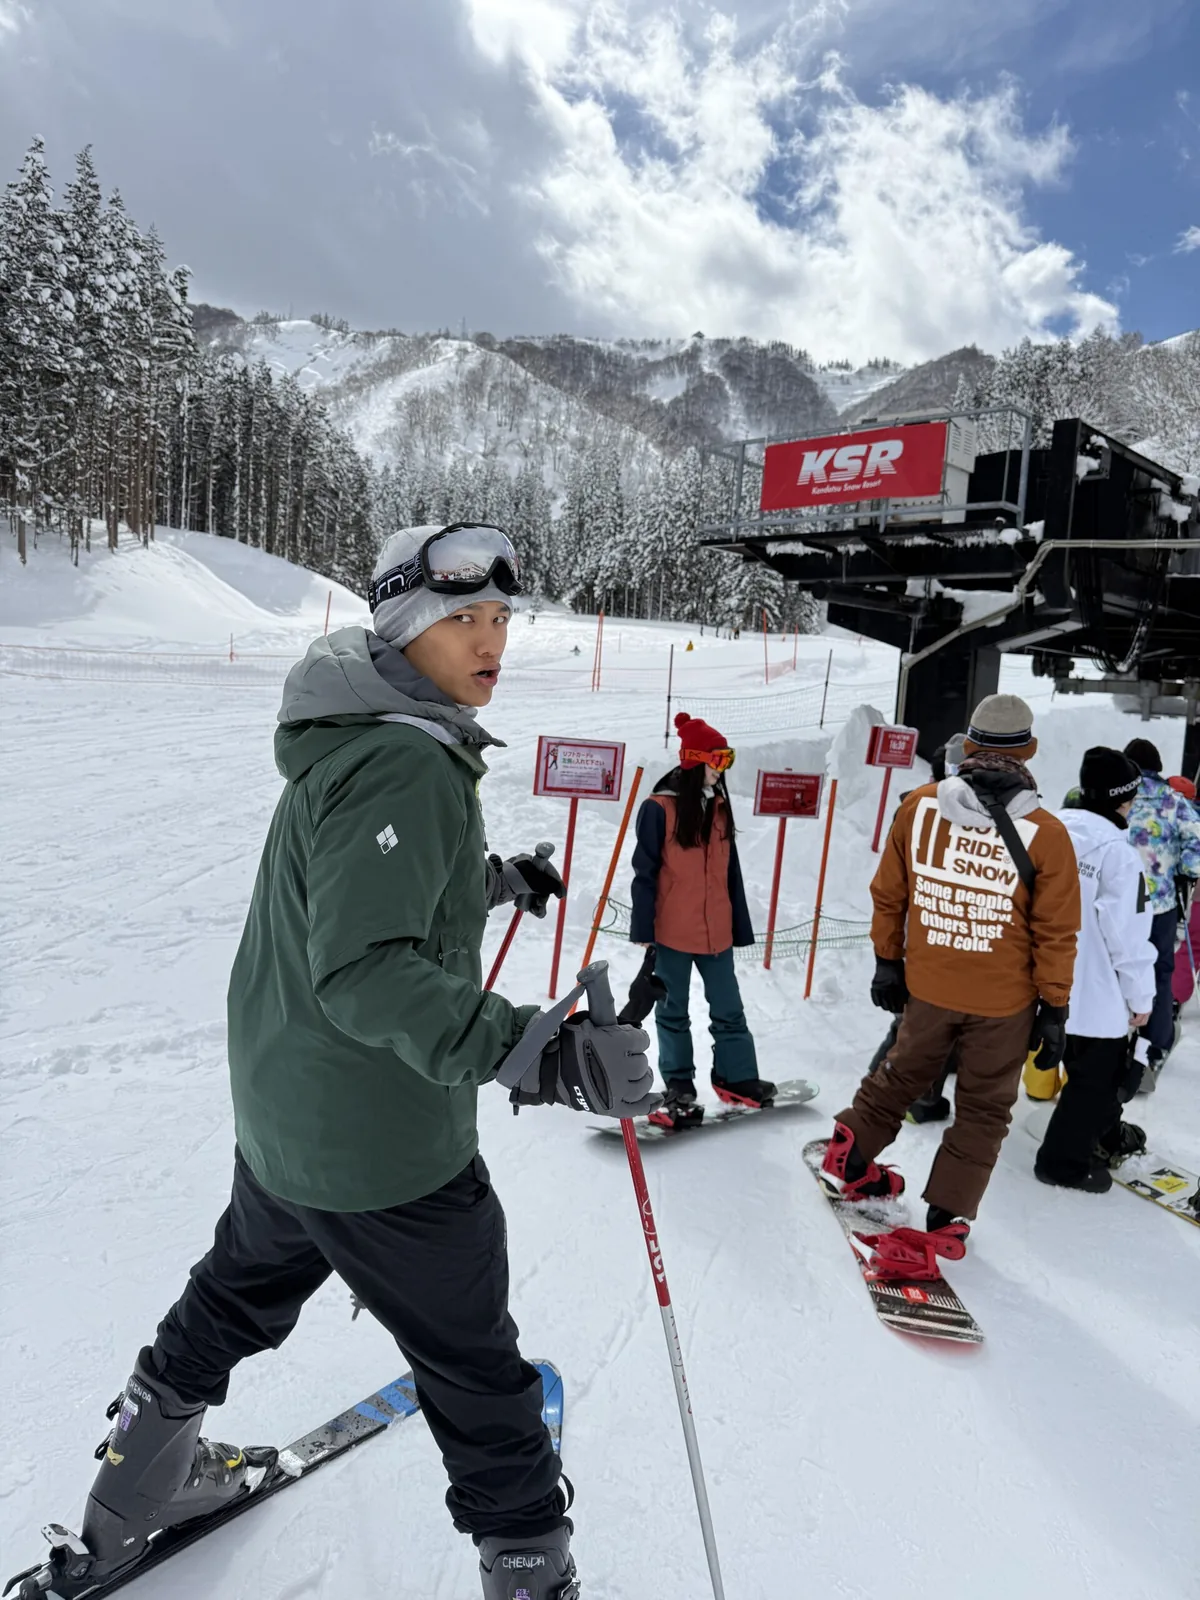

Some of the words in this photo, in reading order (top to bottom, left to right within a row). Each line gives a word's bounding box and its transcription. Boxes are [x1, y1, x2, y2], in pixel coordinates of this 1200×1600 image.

[797, 439, 904, 486] KSR
[843, 482, 861, 492] Snow
[862, 479, 881, 489] Resort
[955, 836, 1005, 862] RIDE
[952, 858, 1016, 886] SNOW
[914, 891, 938, 908] feel
[939, 899, 964, 918] the
[916, 875, 952, 900] Some
[955, 888, 1013, 912] people
[920, 910, 968, 935] Others
[971, 921, 1003, 939] just
[927, 929, 952, 947] get
[953, 936, 993, 953] cold.
[502, 1556, 545, 1569] CHENDA
